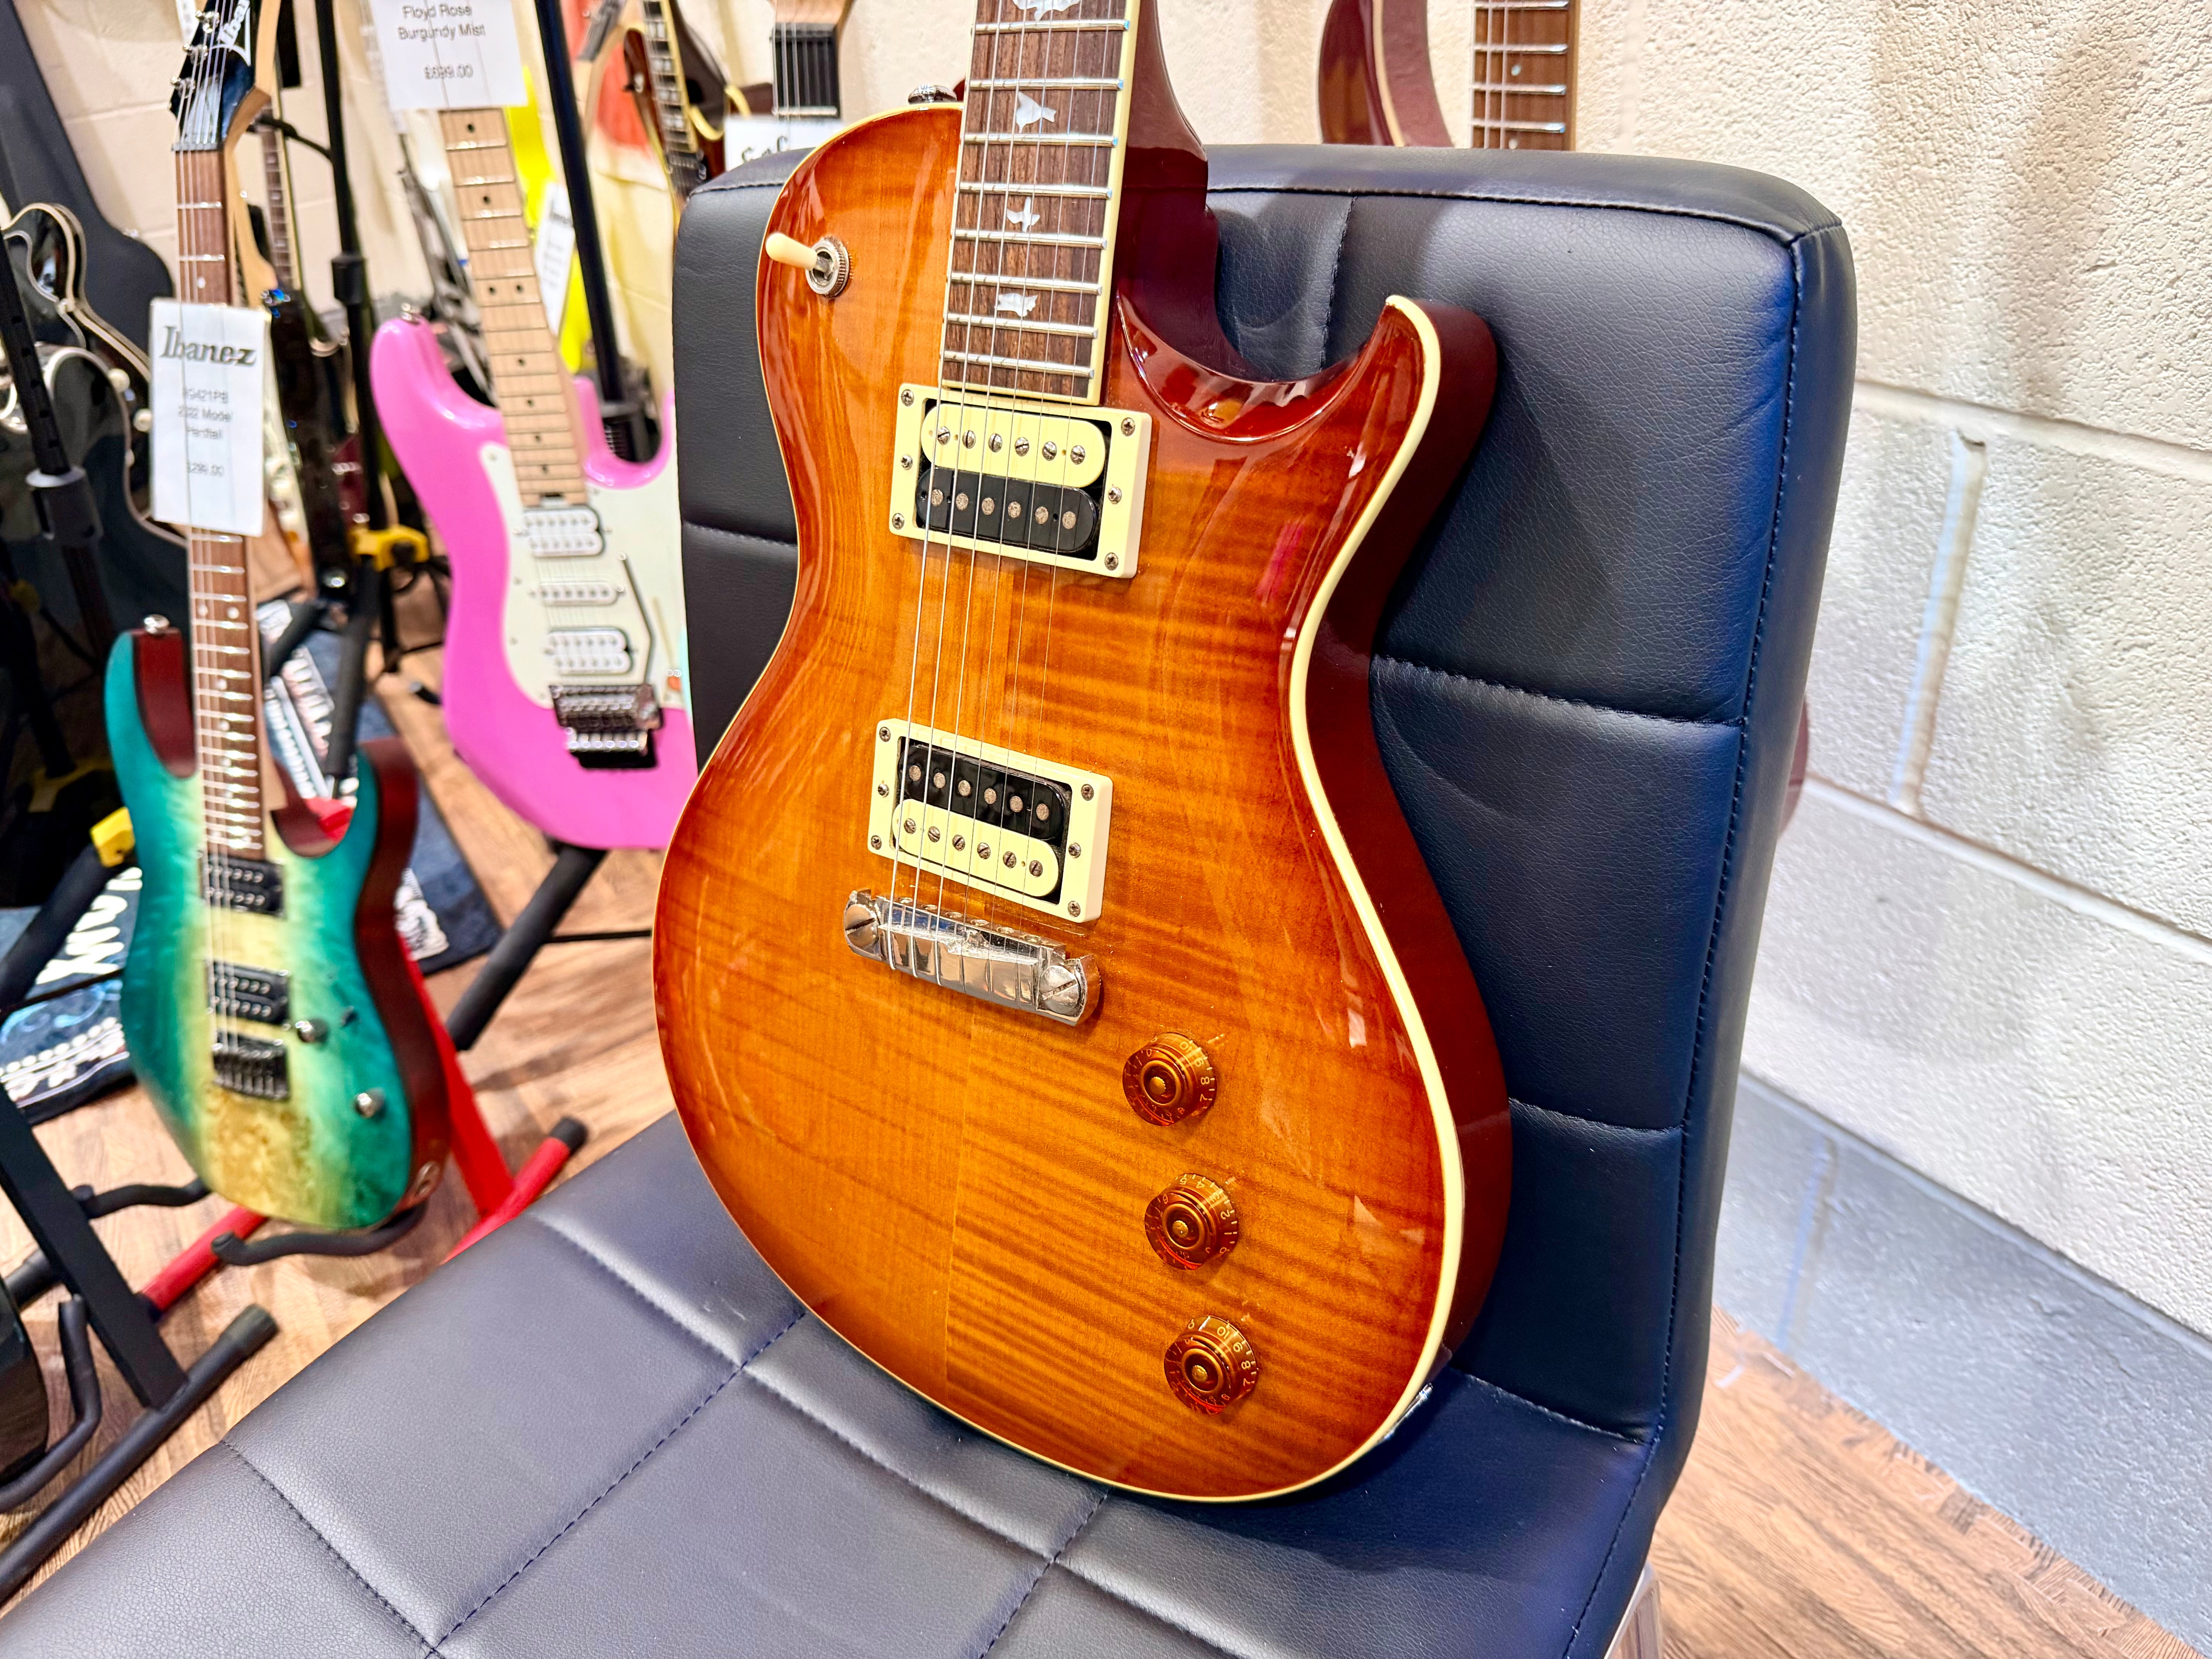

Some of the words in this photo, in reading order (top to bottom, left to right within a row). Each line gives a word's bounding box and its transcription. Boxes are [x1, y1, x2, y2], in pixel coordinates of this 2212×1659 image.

[402, 5, 436, 21] Floyd
[439, 3, 472, 17] Rose
[397, 25, 456, 42] Burgundy
[459, 23, 486, 36] Mist
[159, 325, 257, 366] Ibanez
[178, 405, 198, 419] 222
[1200, 1077, 1210, 1085] 8
[1195, 1180, 1205, 1188] 4
[1210, 1192, 1220, 1203] 3
[1220, 1209, 1230, 1220] 2
[1216, 1326, 1230, 1340] 10
[1241, 1360, 1251, 1370] 8
